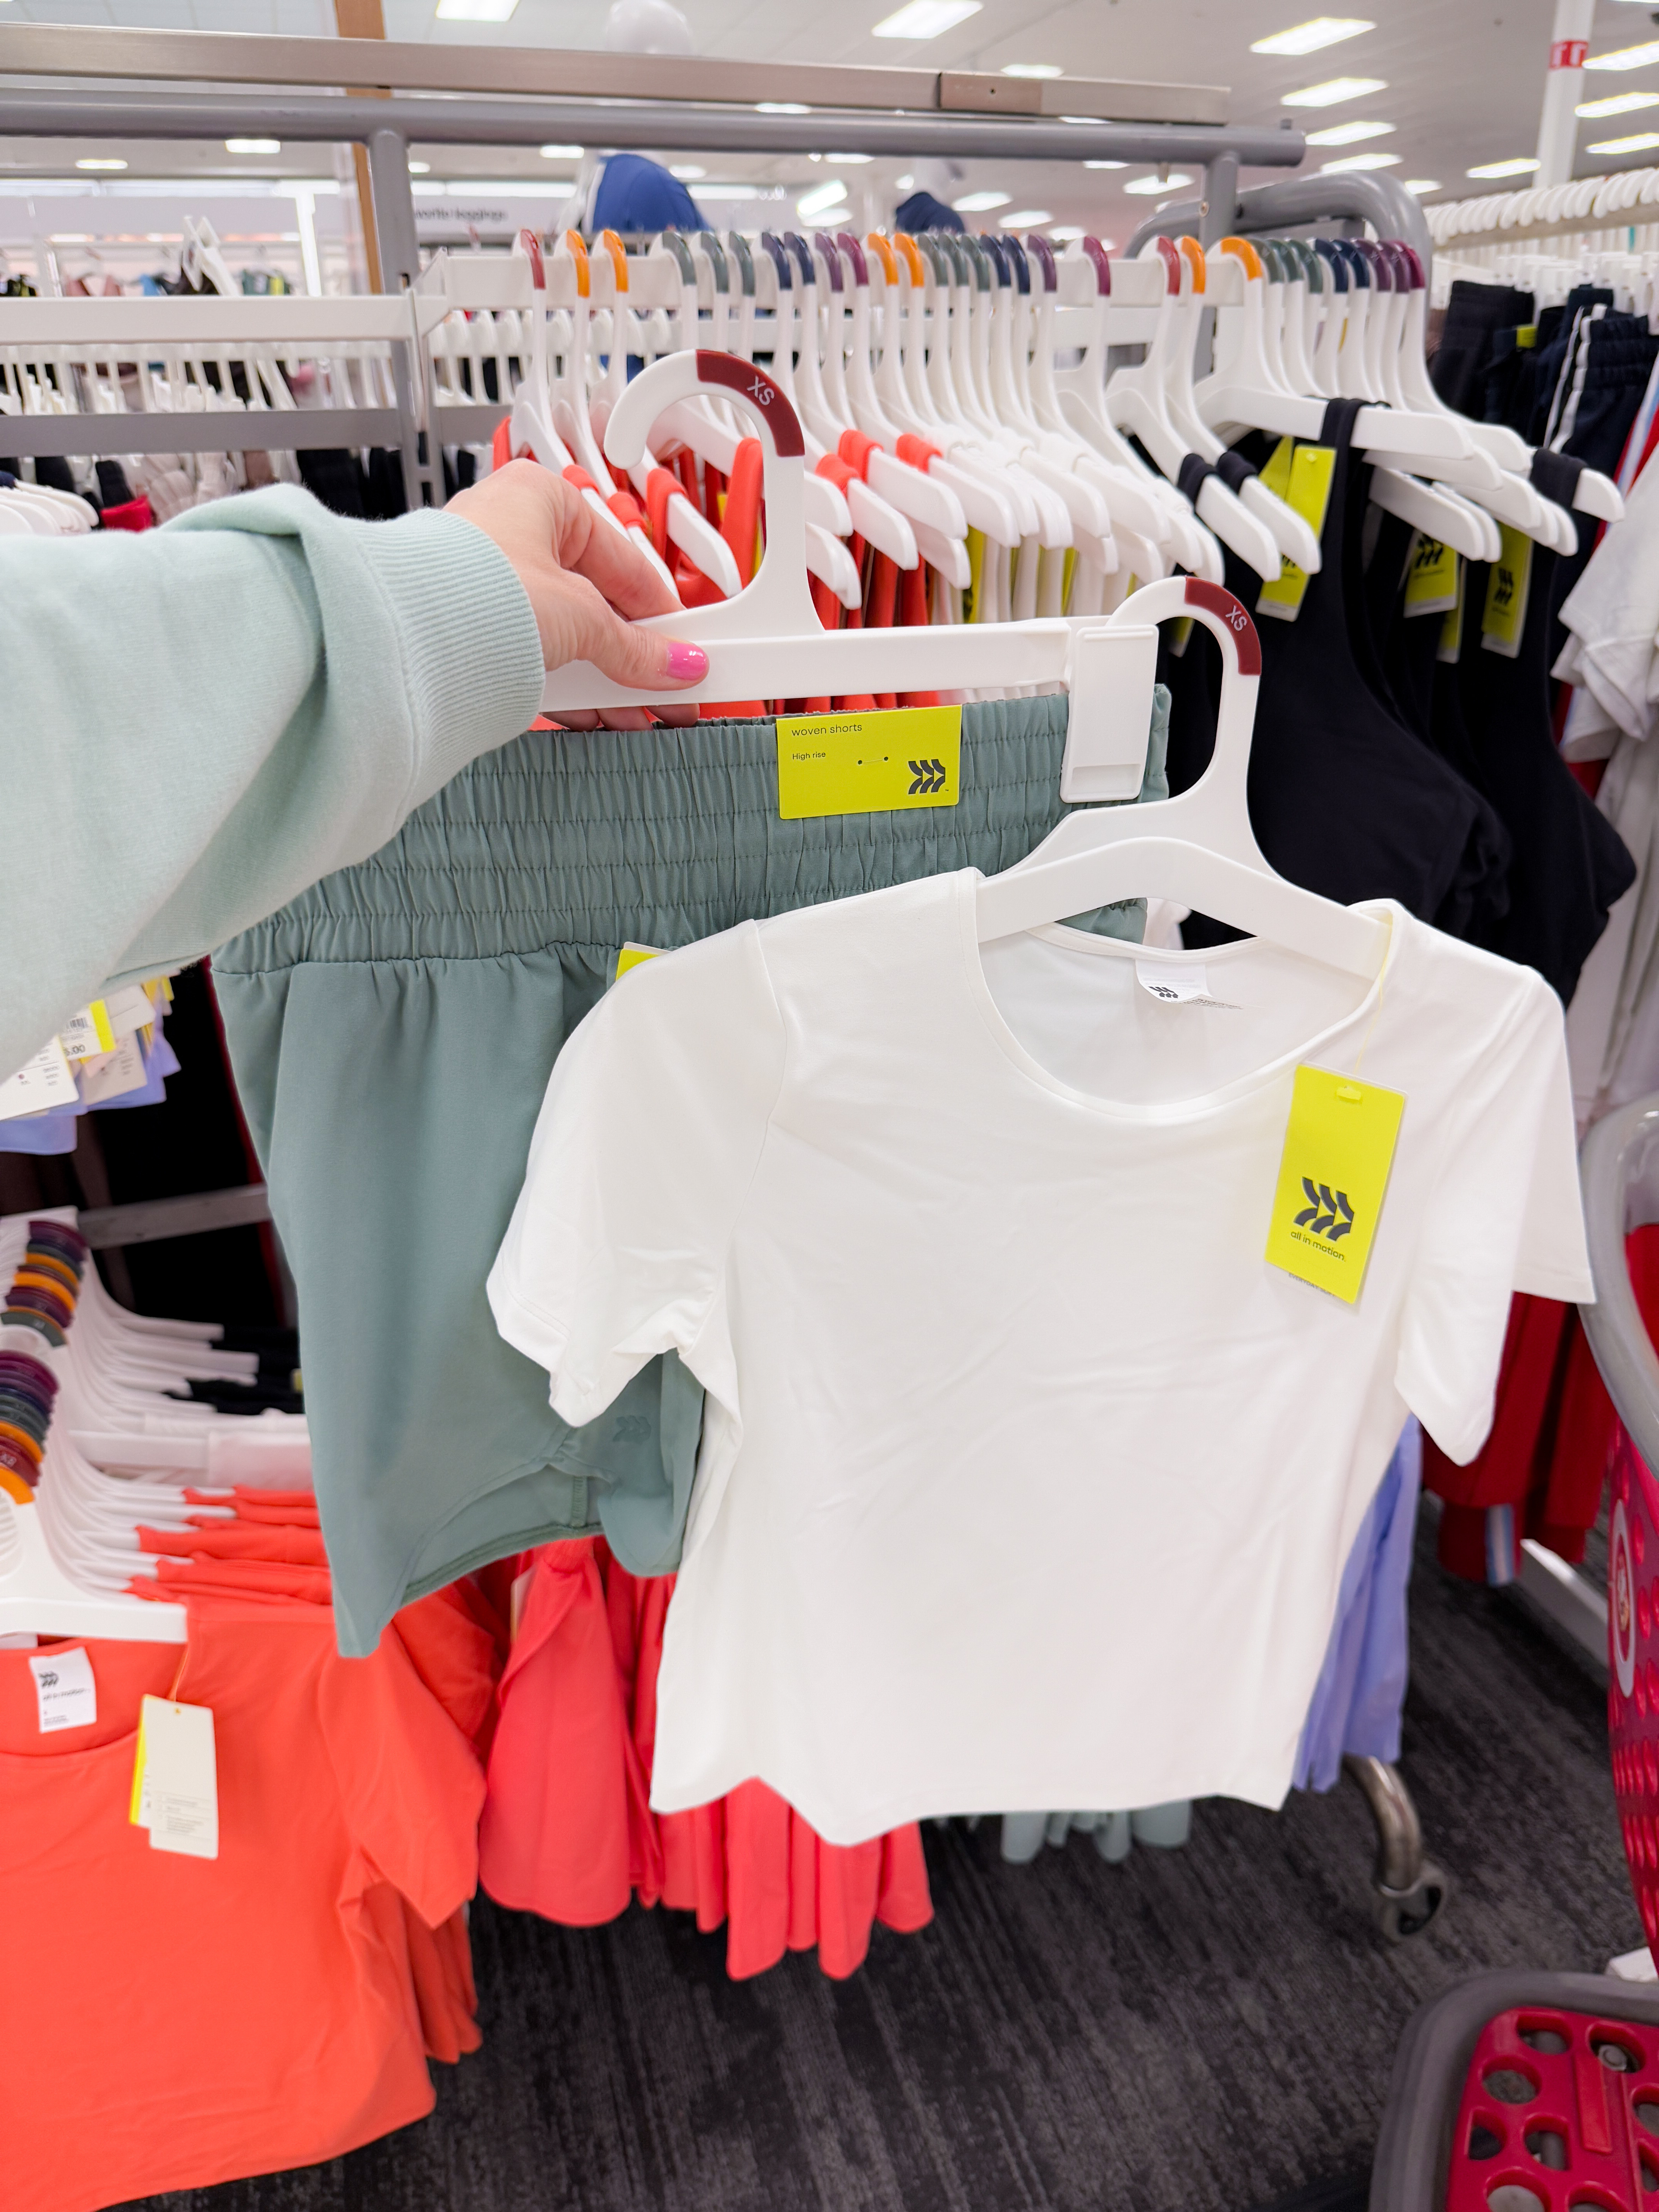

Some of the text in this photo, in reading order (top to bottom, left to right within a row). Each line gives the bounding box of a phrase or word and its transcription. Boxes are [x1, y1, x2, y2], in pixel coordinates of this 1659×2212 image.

[747, 376, 775, 405] XS
[1225, 605, 1247, 631] XS
[792, 724, 862, 736] woven shorts
[792, 752, 810, 761] High
[1290, 1231, 1344, 1261] all in motion
